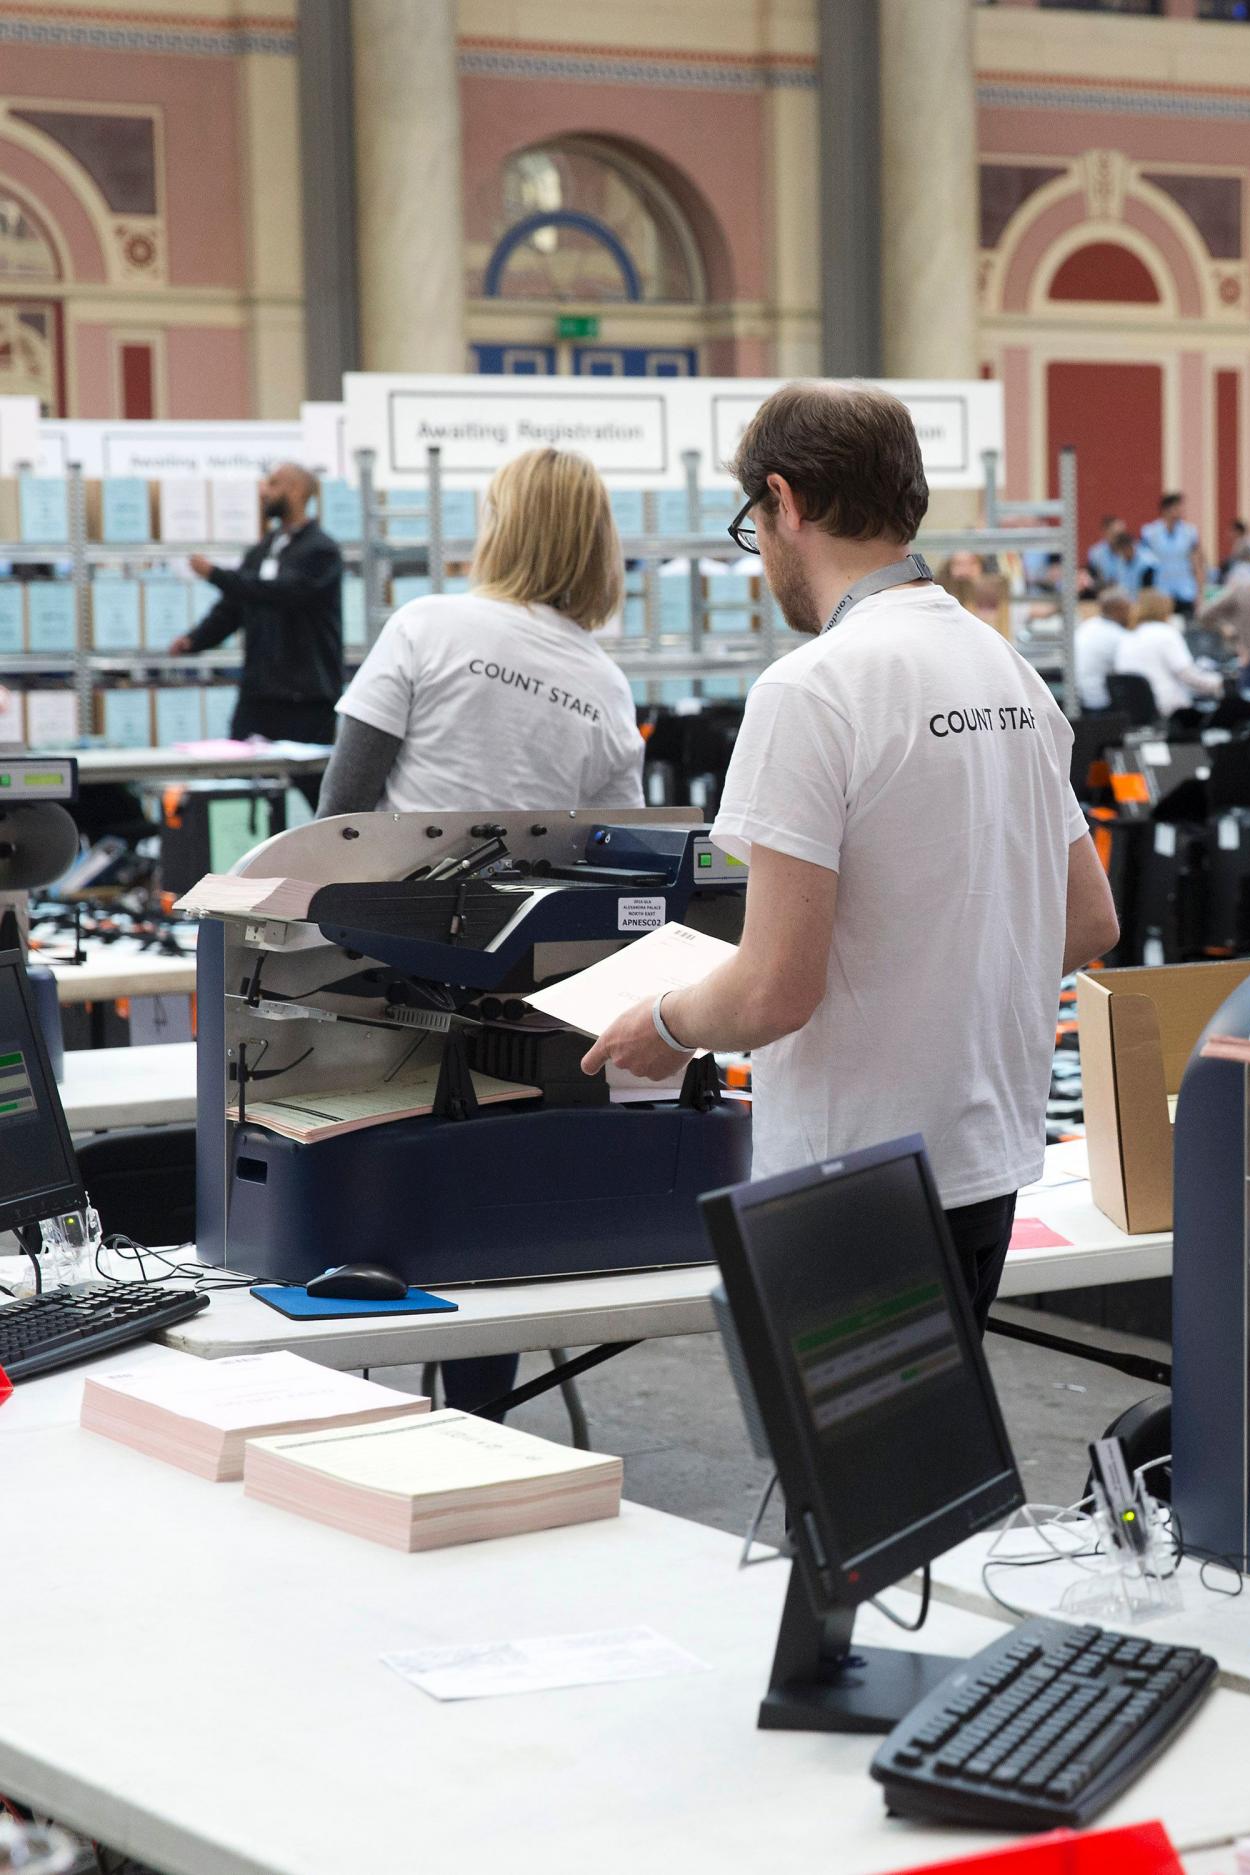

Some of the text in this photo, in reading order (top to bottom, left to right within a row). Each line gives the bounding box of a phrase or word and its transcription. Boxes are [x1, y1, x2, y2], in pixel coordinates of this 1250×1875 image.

[417, 419, 644, 443] Awaiting Registration
[469, 659, 600, 722] COUNT STAFF
[929, 707, 994, 737] COUNT
[622, 919, 661, 927] APNESC02
